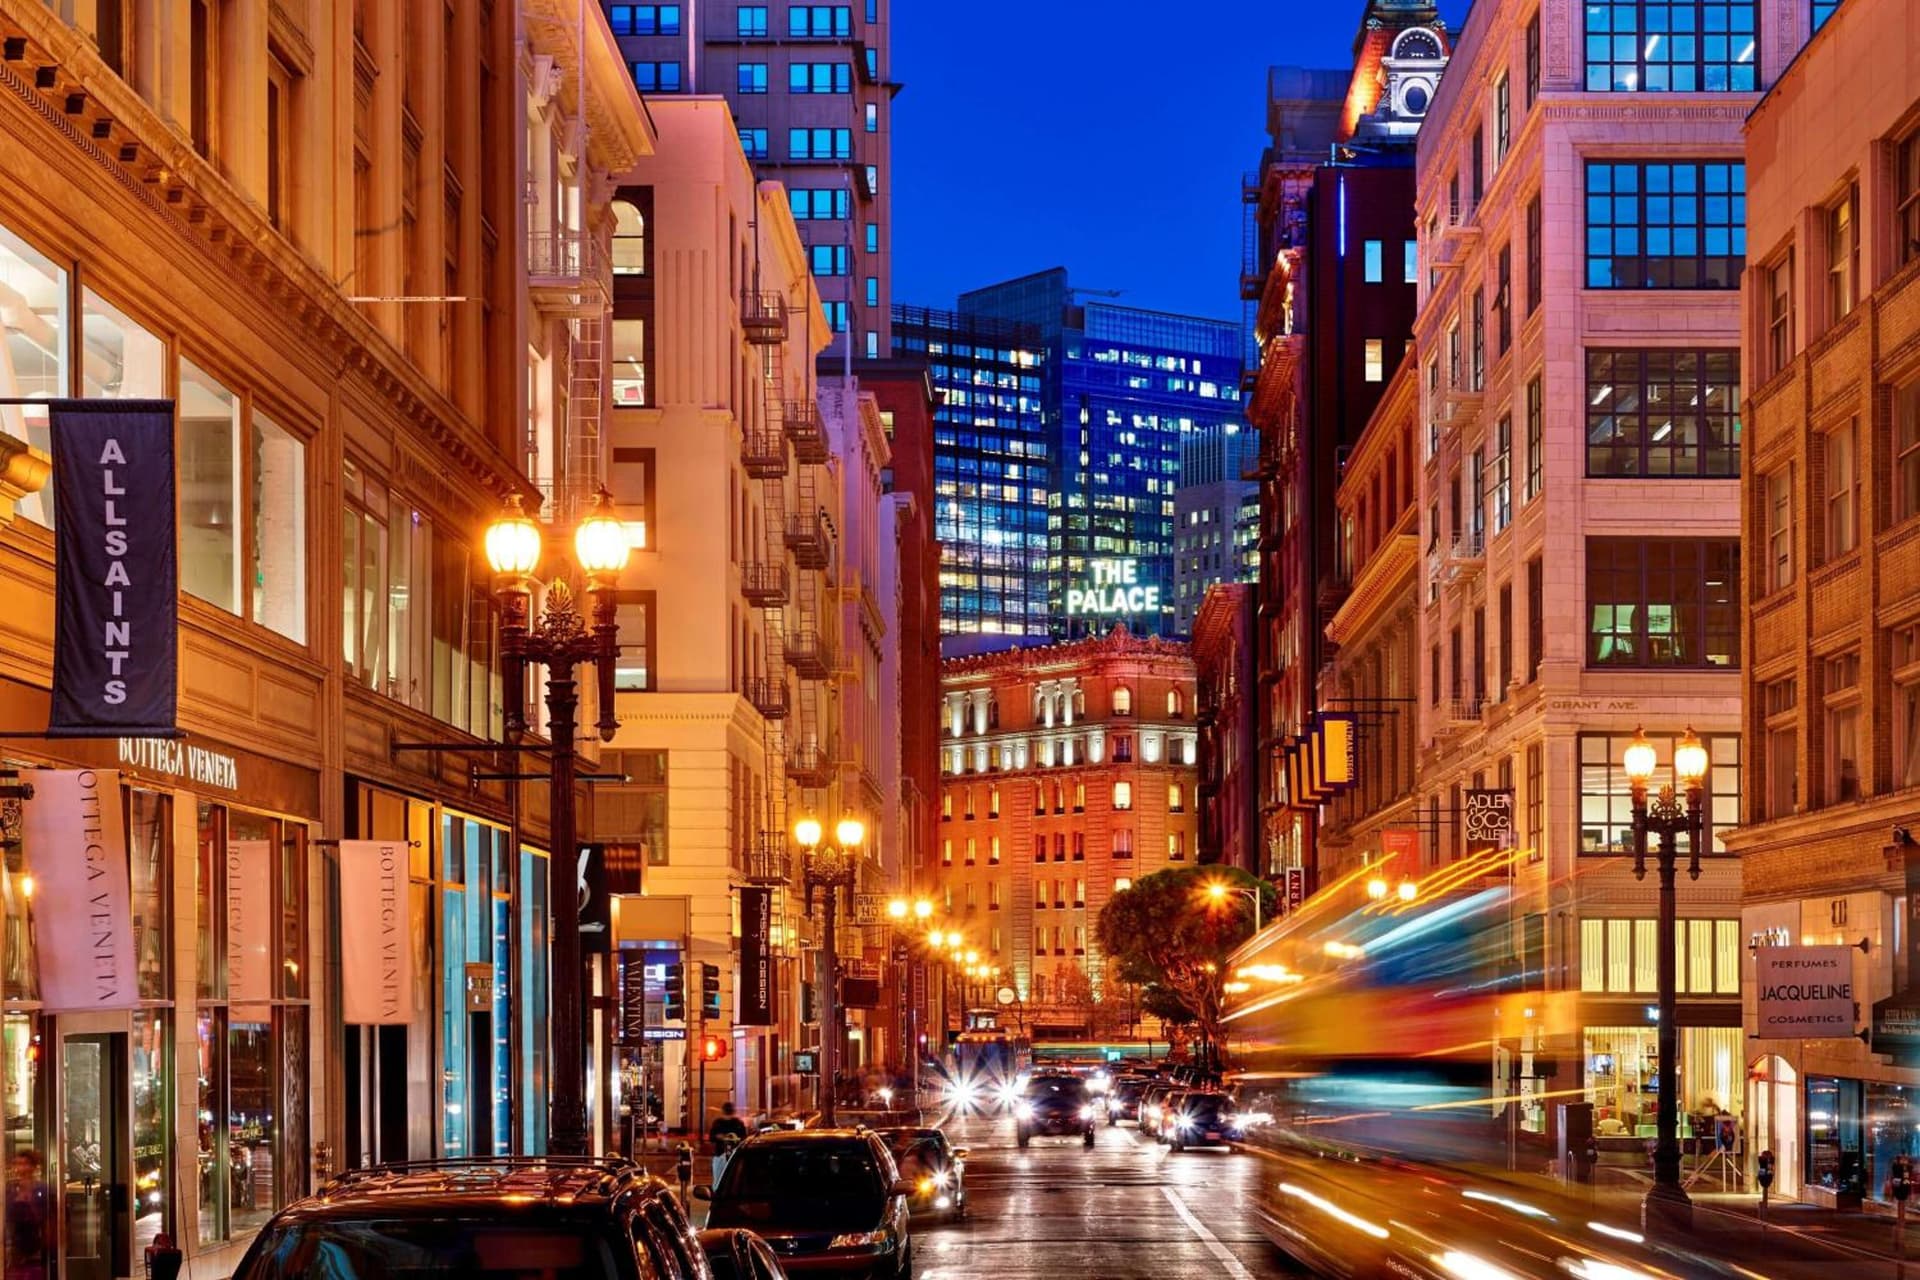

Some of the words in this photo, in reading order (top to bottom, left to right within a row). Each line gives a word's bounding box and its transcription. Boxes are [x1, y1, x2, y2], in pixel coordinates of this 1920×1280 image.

[100, 439, 130, 705] ALLSAINTS
[1091, 559, 1137, 585] THE
[1067, 586, 1160, 615] PALACE
[1552, 701, 1601, 710] GRANT
[119, 736, 185, 776] BOTTEGA
[187, 744, 238, 791] VENETA
[78, 770, 105, 881] OTTEGA
[1467, 829, 1508, 841] GALLE
[381, 846, 396, 935] BOTTEGA
[89, 893, 118, 1001] VENETA
[759, 893, 768, 957] PORSCHE
[383, 942, 398, 1018] VENETA
[759, 960, 767, 1009] DESIGN
[1771, 959, 1838, 969] PERFUMES
[627, 960, 641, 1038] VALENTINO
[1760, 983, 1850, 1002] JACQUELINE
[643, 1030, 685, 1038] ESIGN
[1767, 1015, 1845, 1025] COSMETICS
